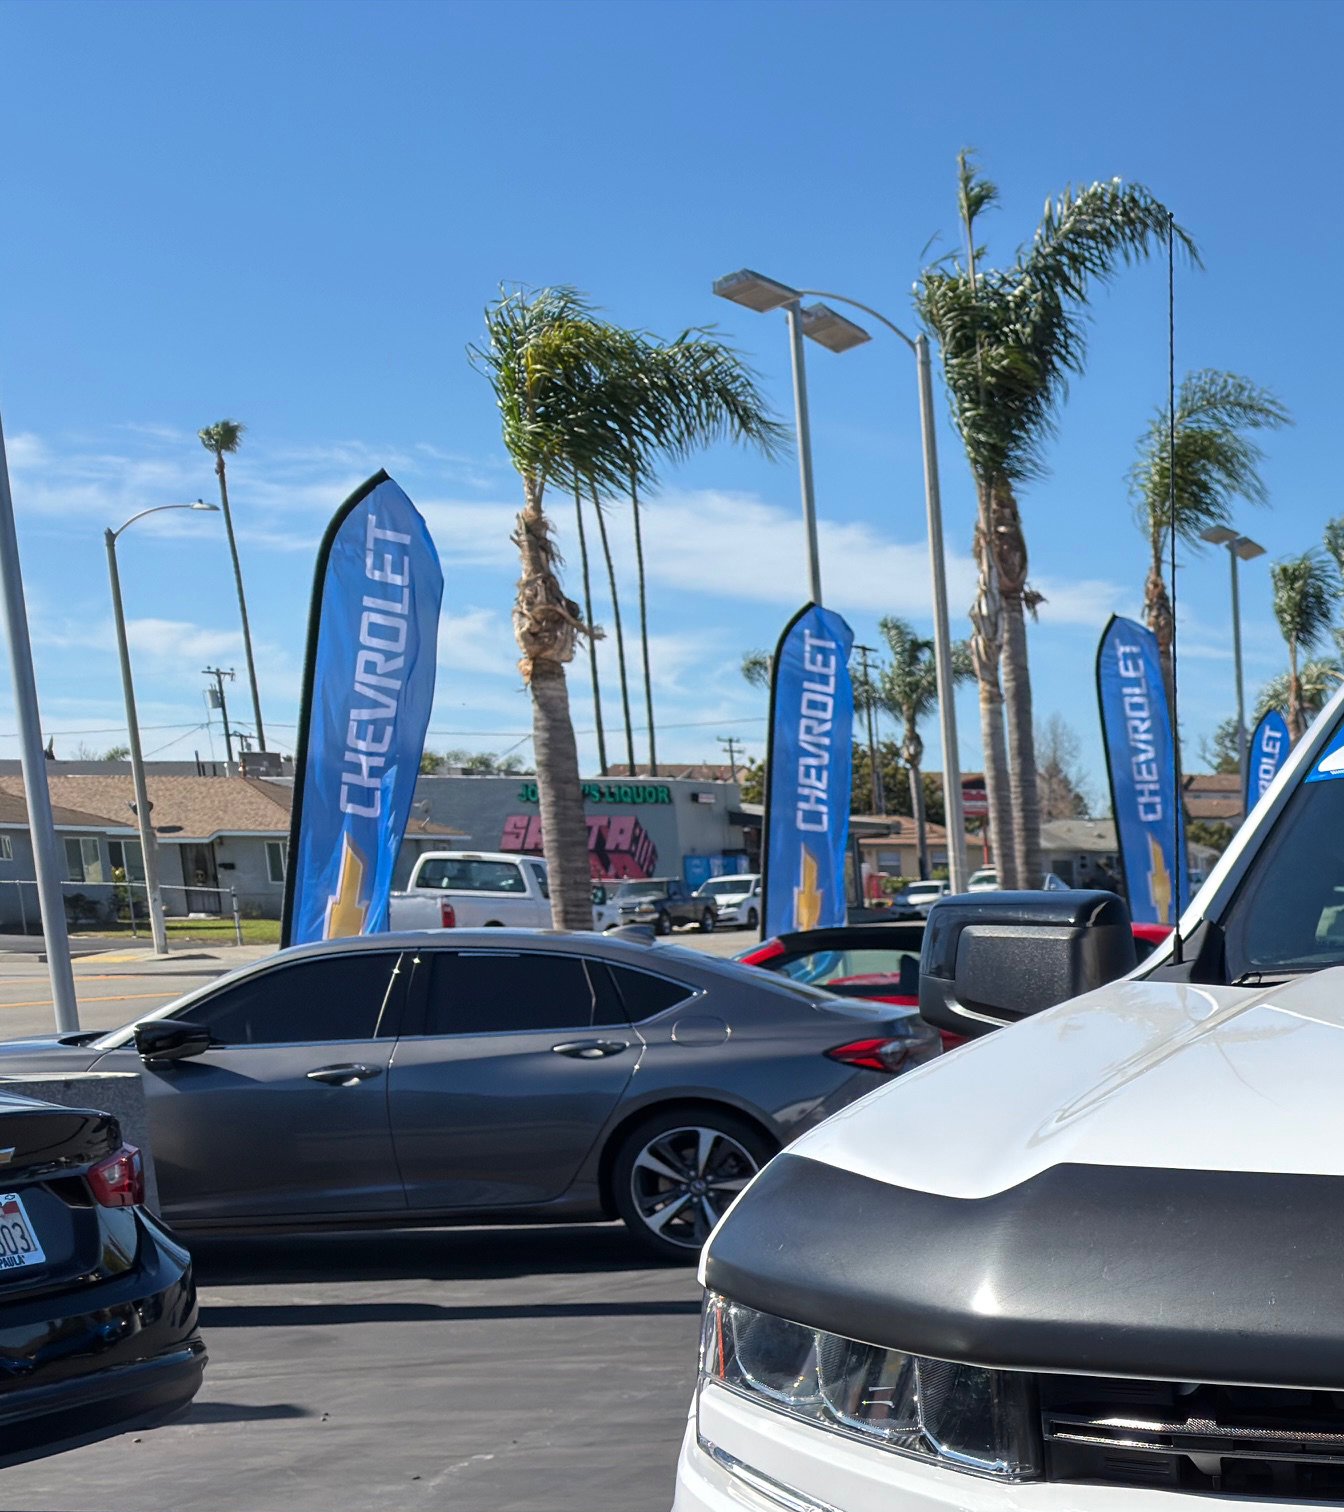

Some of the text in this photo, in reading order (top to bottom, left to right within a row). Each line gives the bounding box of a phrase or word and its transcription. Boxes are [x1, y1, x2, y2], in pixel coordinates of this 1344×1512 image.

[340, 514, 411, 818] CHEVROLET
[796, 629, 836, 832] CHEVROLET
[1114, 638, 1162, 822] CHEVROLET
[499, 815, 637, 850] SATA
[604, 785, 672, 804] LIQUOR
